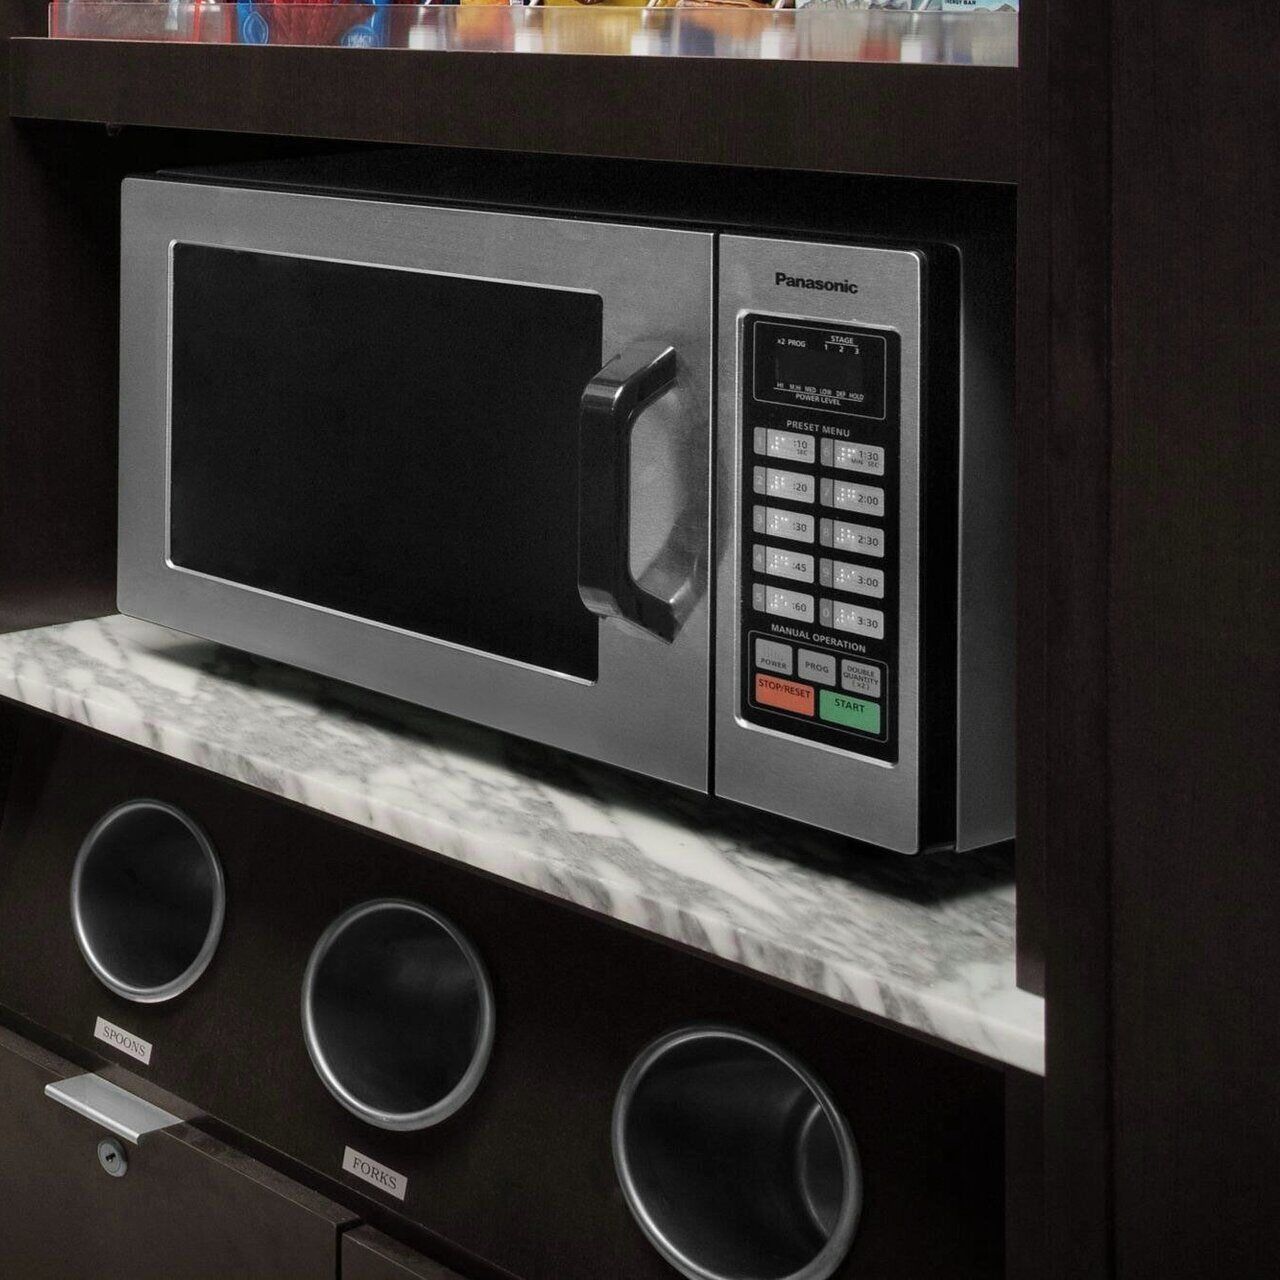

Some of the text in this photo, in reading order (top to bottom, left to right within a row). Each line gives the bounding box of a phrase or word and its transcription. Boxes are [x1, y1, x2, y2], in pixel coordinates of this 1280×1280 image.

[775, 272, 858, 294] Panasonic
[788, 338, 806, 347] PROG
[831, 335, 854, 344] STAGE
[796, 393, 841, 406] POWER LEVEL
[787, 420, 850, 437] PRESET MENU
[858, 494, 878, 506] 2:00
[858, 535, 878, 546] 2:30
[857, 576, 878, 587] 3:00
[857, 617, 878, 628] 3:30
[771, 624, 866, 653] MANUAL OPERATION
[760, 657, 787, 670] POWER
[805, 661, 829, 673] PROG
[847, 665, 875, 677] DOUBLE
[843, 672, 878, 685] QUANTITY
[759, 679, 810, 699] STOP/RESET
[834, 698, 865, 713] START
[102, 1026, 146, 1057] SPOONS
[352, 1157, 397, 1190] FORKS
